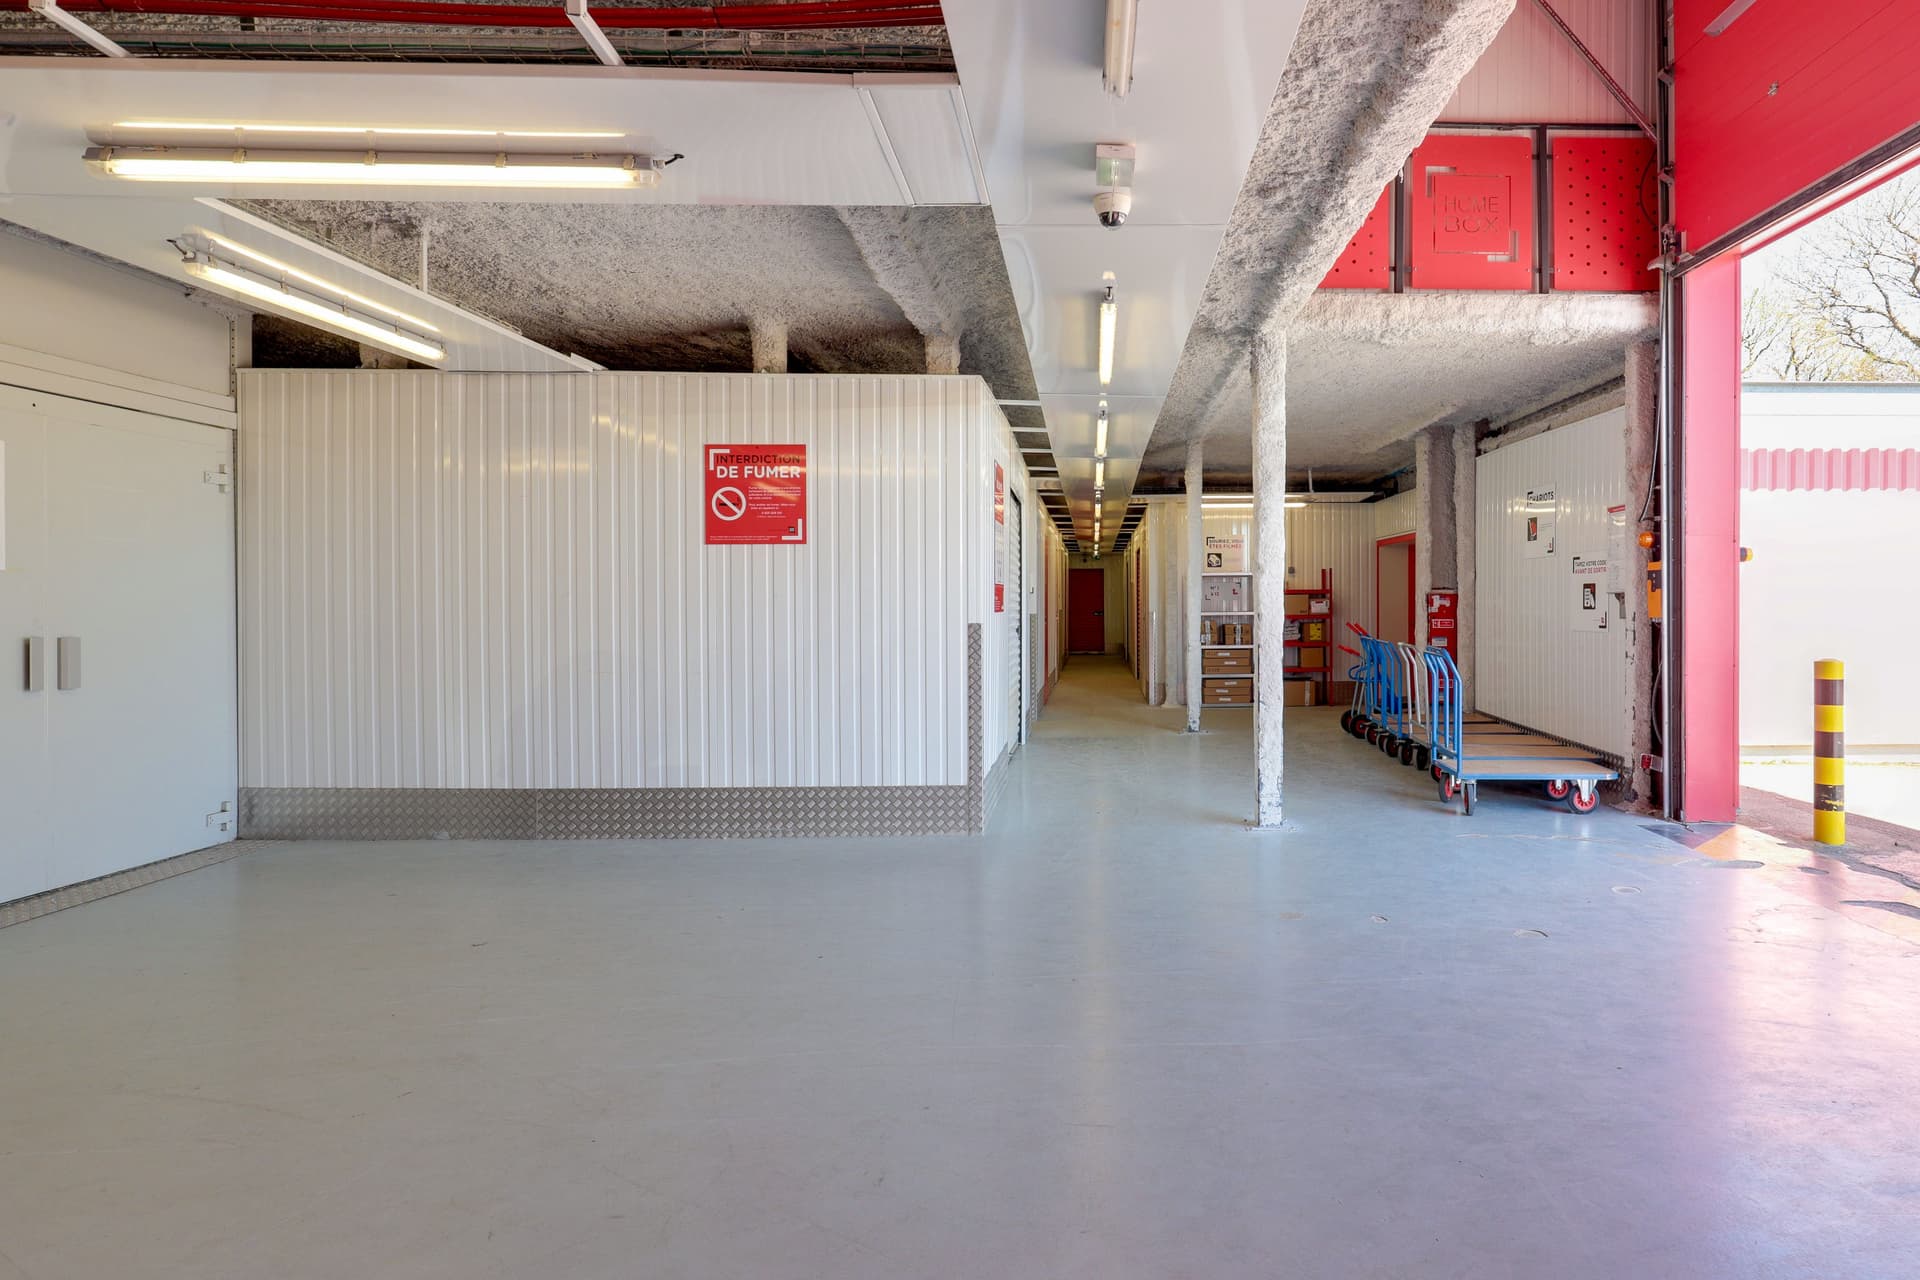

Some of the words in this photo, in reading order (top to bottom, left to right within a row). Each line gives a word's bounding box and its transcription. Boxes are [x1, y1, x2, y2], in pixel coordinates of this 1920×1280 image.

[1444, 195, 1499, 213] HOME
[1444, 216, 1498, 233] BOX
[716, 455, 800, 464] INTERDICTION
[716, 465, 738, 478] DE
[744, 465, 801, 478] FUMER
